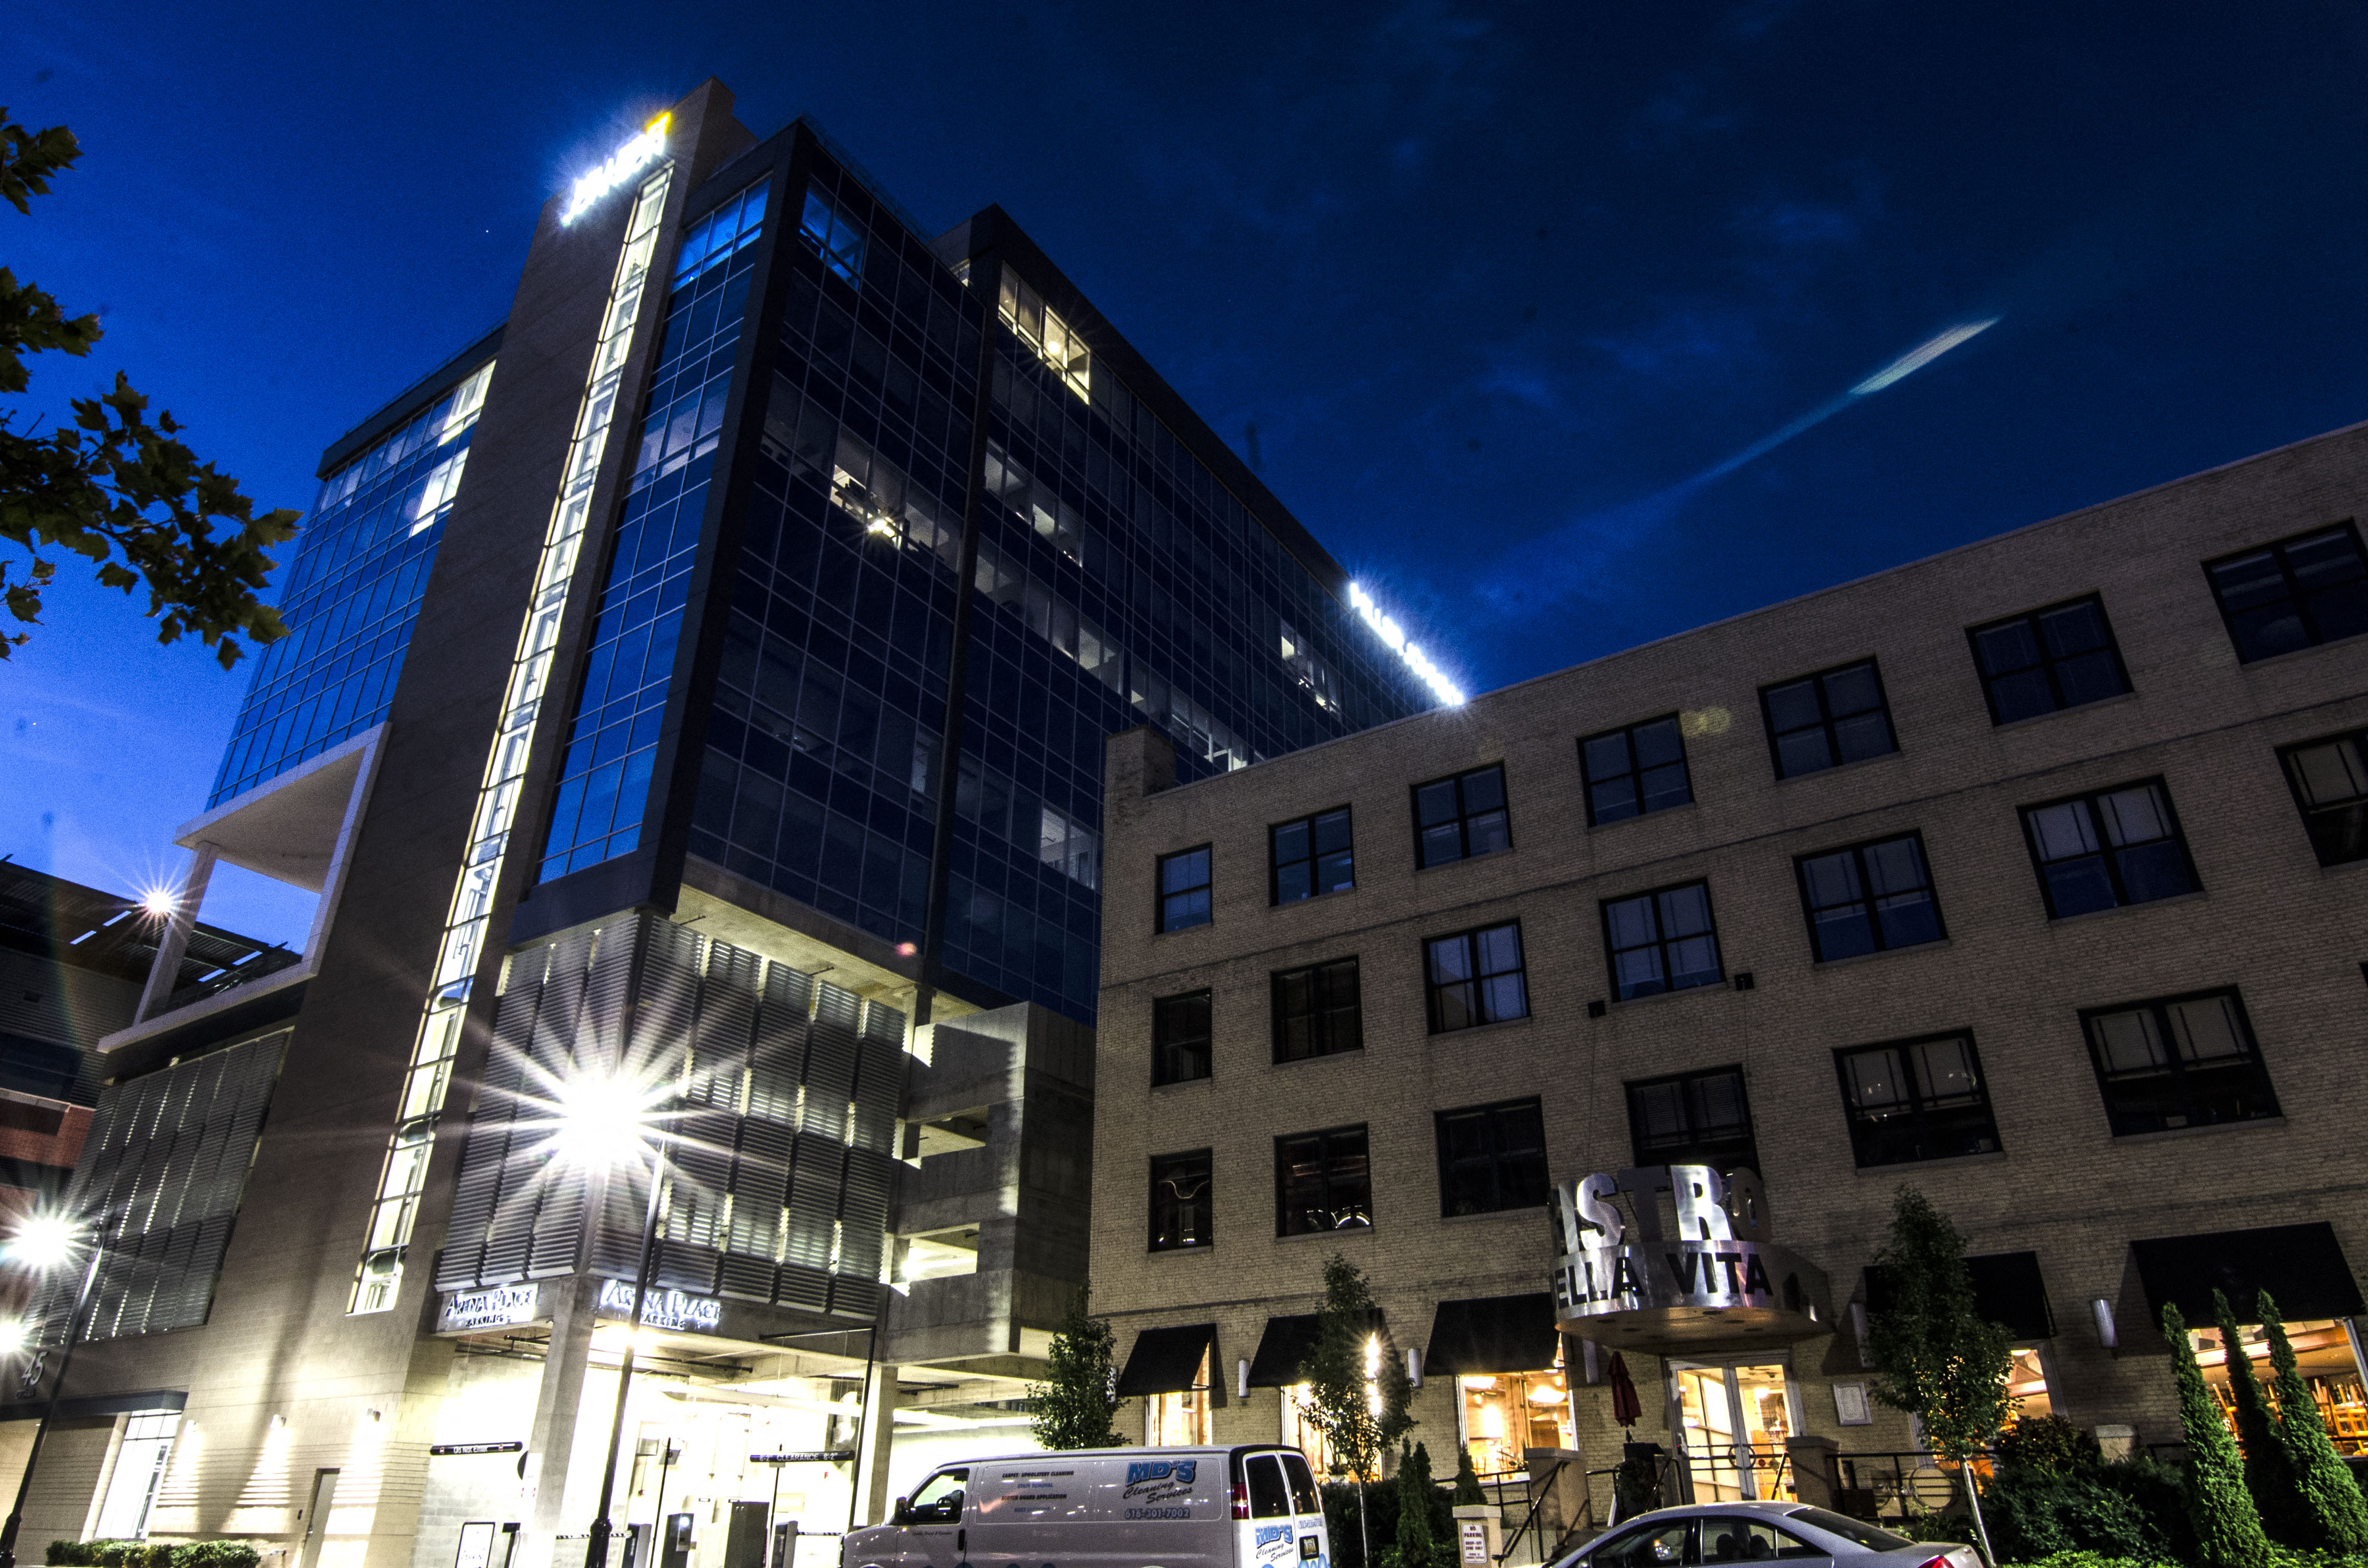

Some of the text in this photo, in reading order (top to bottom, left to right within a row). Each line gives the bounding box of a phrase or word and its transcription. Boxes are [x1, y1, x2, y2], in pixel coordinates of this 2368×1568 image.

[1557, 1164, 1772, 1254] ISTRO
[1554, 1253, 1773, 1309] ELLA VITA
[445, 1290, 533, 1317] ARENA PLACE
[606, 1280, 664, 1313] ARNA
[643, 1313, 686, 1329] ARKING
[21, 1351, 47, 1385] 45
[777, 1453, 819, 1461] CLEARANCE
[1126, 1460, 1197, 1486] MD'S
[1122, 1481, 1175, 1499] Cleaning
[1146, 1487, 1192, 1504] Services
[1125, 1508, 1190, 1520] 616-301-7002
[1255, 1524, 1293, 1549] MD'S
[1256, 1543, 1284, 1559] Cleaning
[1270, 1547, 1294, 1562] Services
